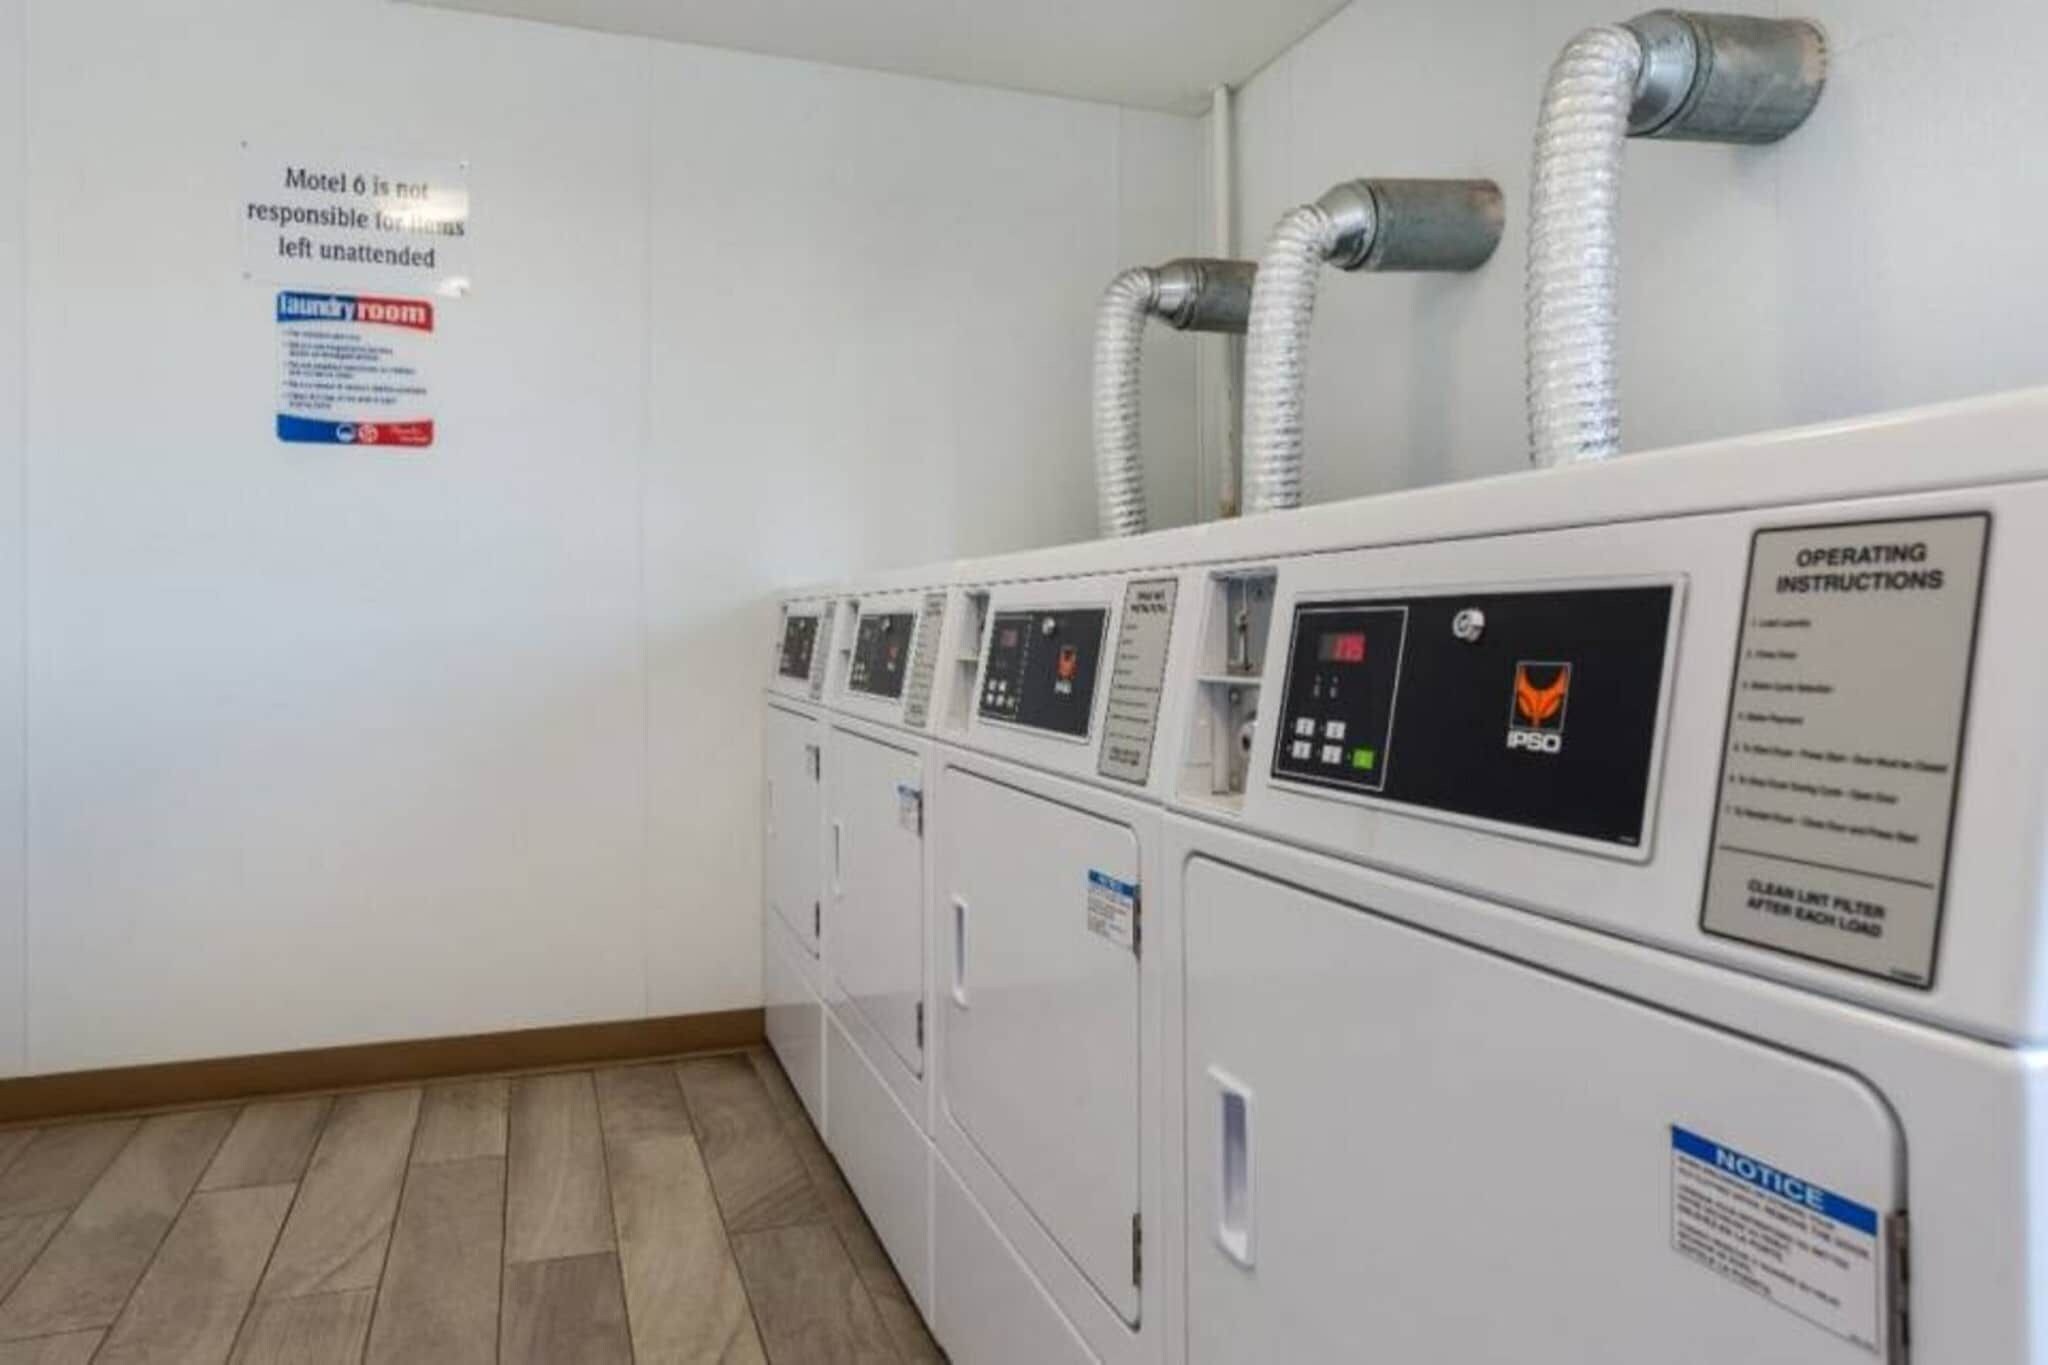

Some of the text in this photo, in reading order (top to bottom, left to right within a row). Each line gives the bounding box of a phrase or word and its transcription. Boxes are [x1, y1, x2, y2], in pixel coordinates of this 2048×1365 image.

[284, 166, 430, 200] Motel 6 is not
[248, 202, 369, 229] responsible
[278, 235, 436, 269] left unattended
[279, 294, 426, 324] laundry room
[1795, 542, 1927, 568] OPERATING
[1775, 569, 1945, 595] INSTRUCTIONS
[1506, 730, 1562, 755] IPSO
[1747, 878, 1886, 920] CLEAN LINT FILTER
[1746, 897, 1884, 939] AFTER EACH LOAD
[1715, 1147, 1825, 1211] NOTICE
